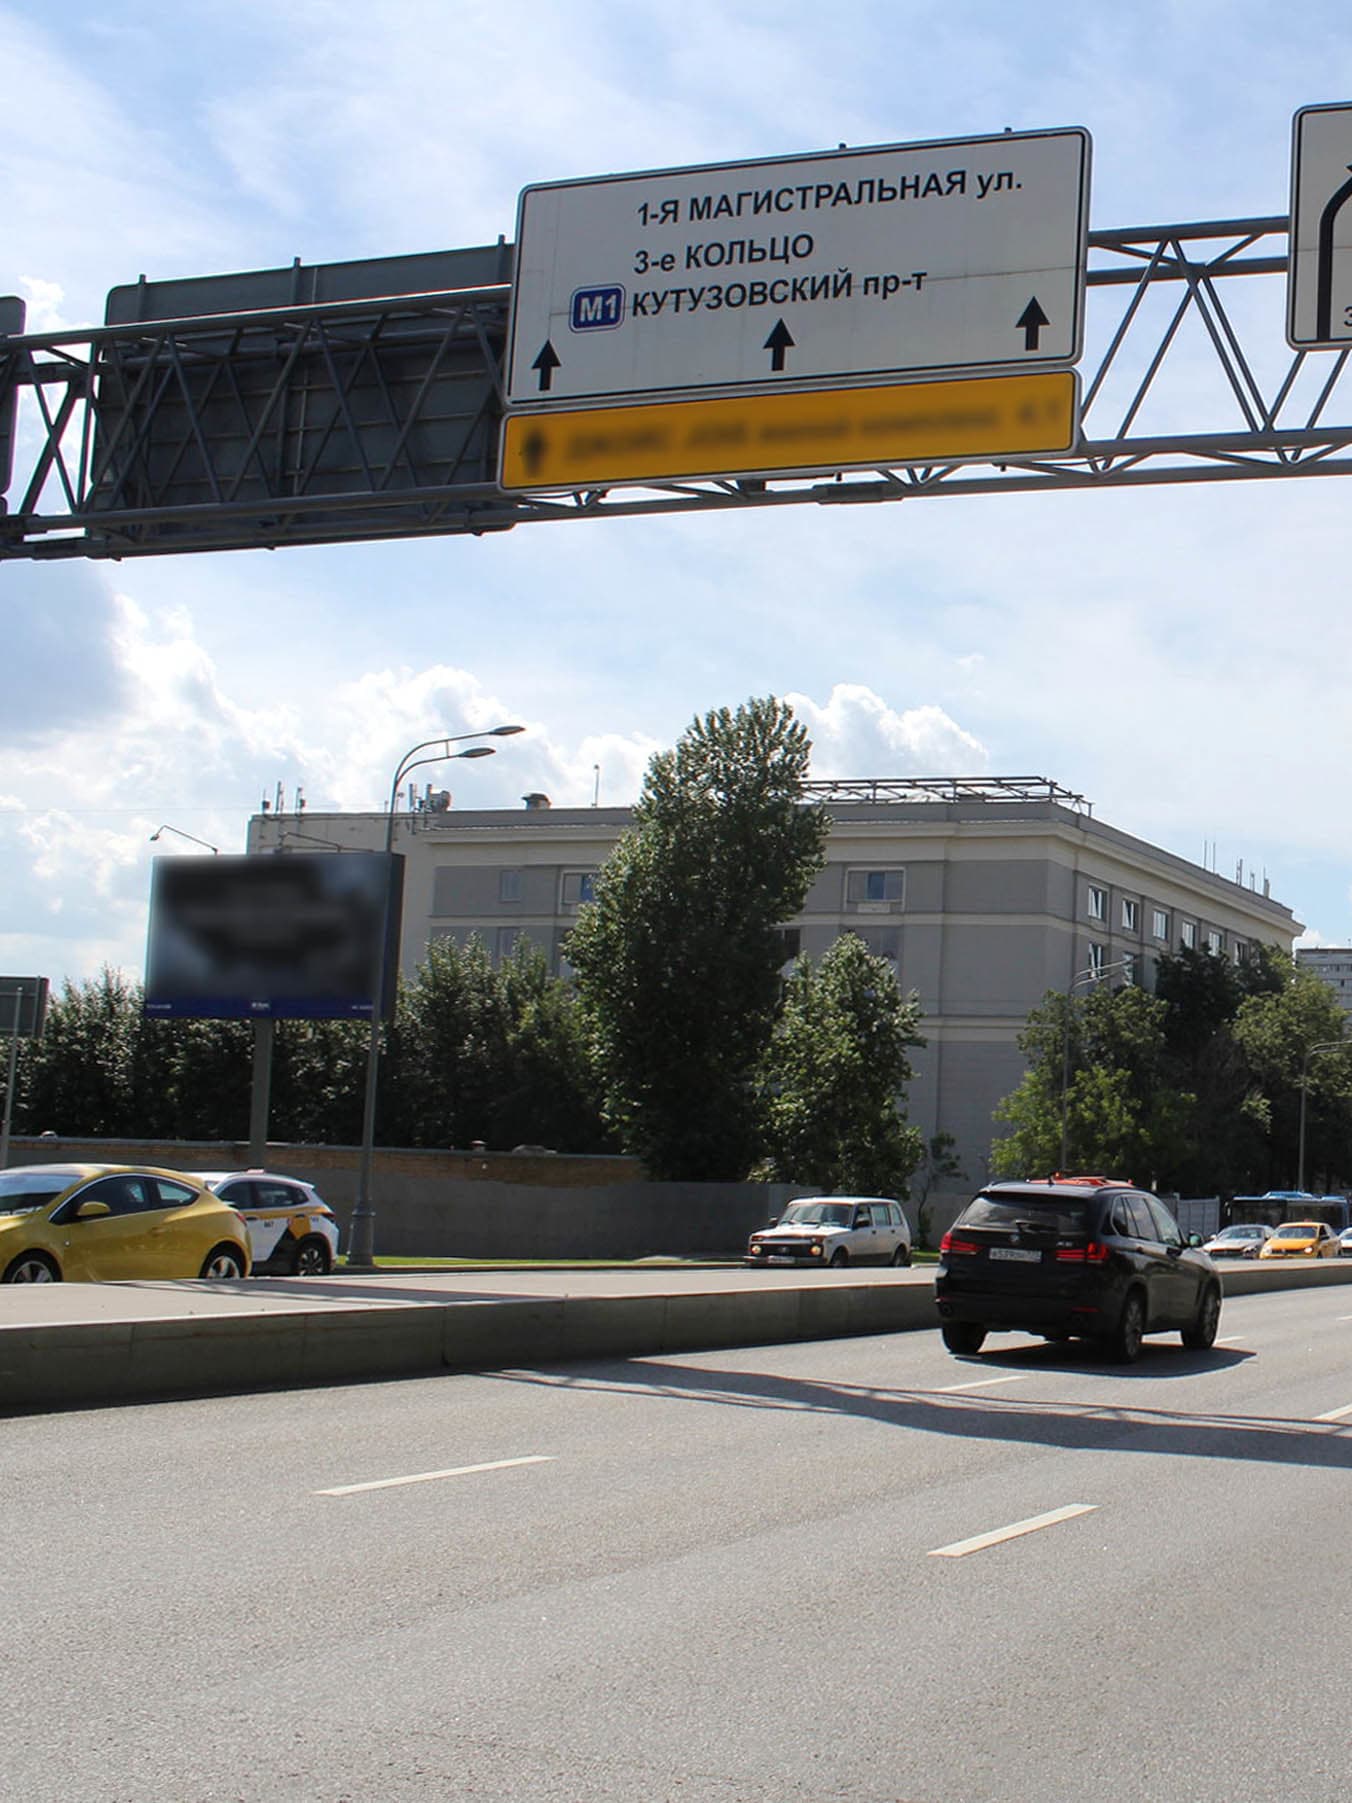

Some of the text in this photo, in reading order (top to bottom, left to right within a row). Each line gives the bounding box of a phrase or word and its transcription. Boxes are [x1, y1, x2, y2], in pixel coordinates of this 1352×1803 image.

[637, 170, 1022, 226] 1-Я МАГИСТРАЛЬНАЯ ул.
[633, 233, 815, 275] 3-е КОЛЬЦО
[579, 295, 620, 324] М1
[632, 266, 927, 318] КУТУЗОВСКИЙ пр-т
